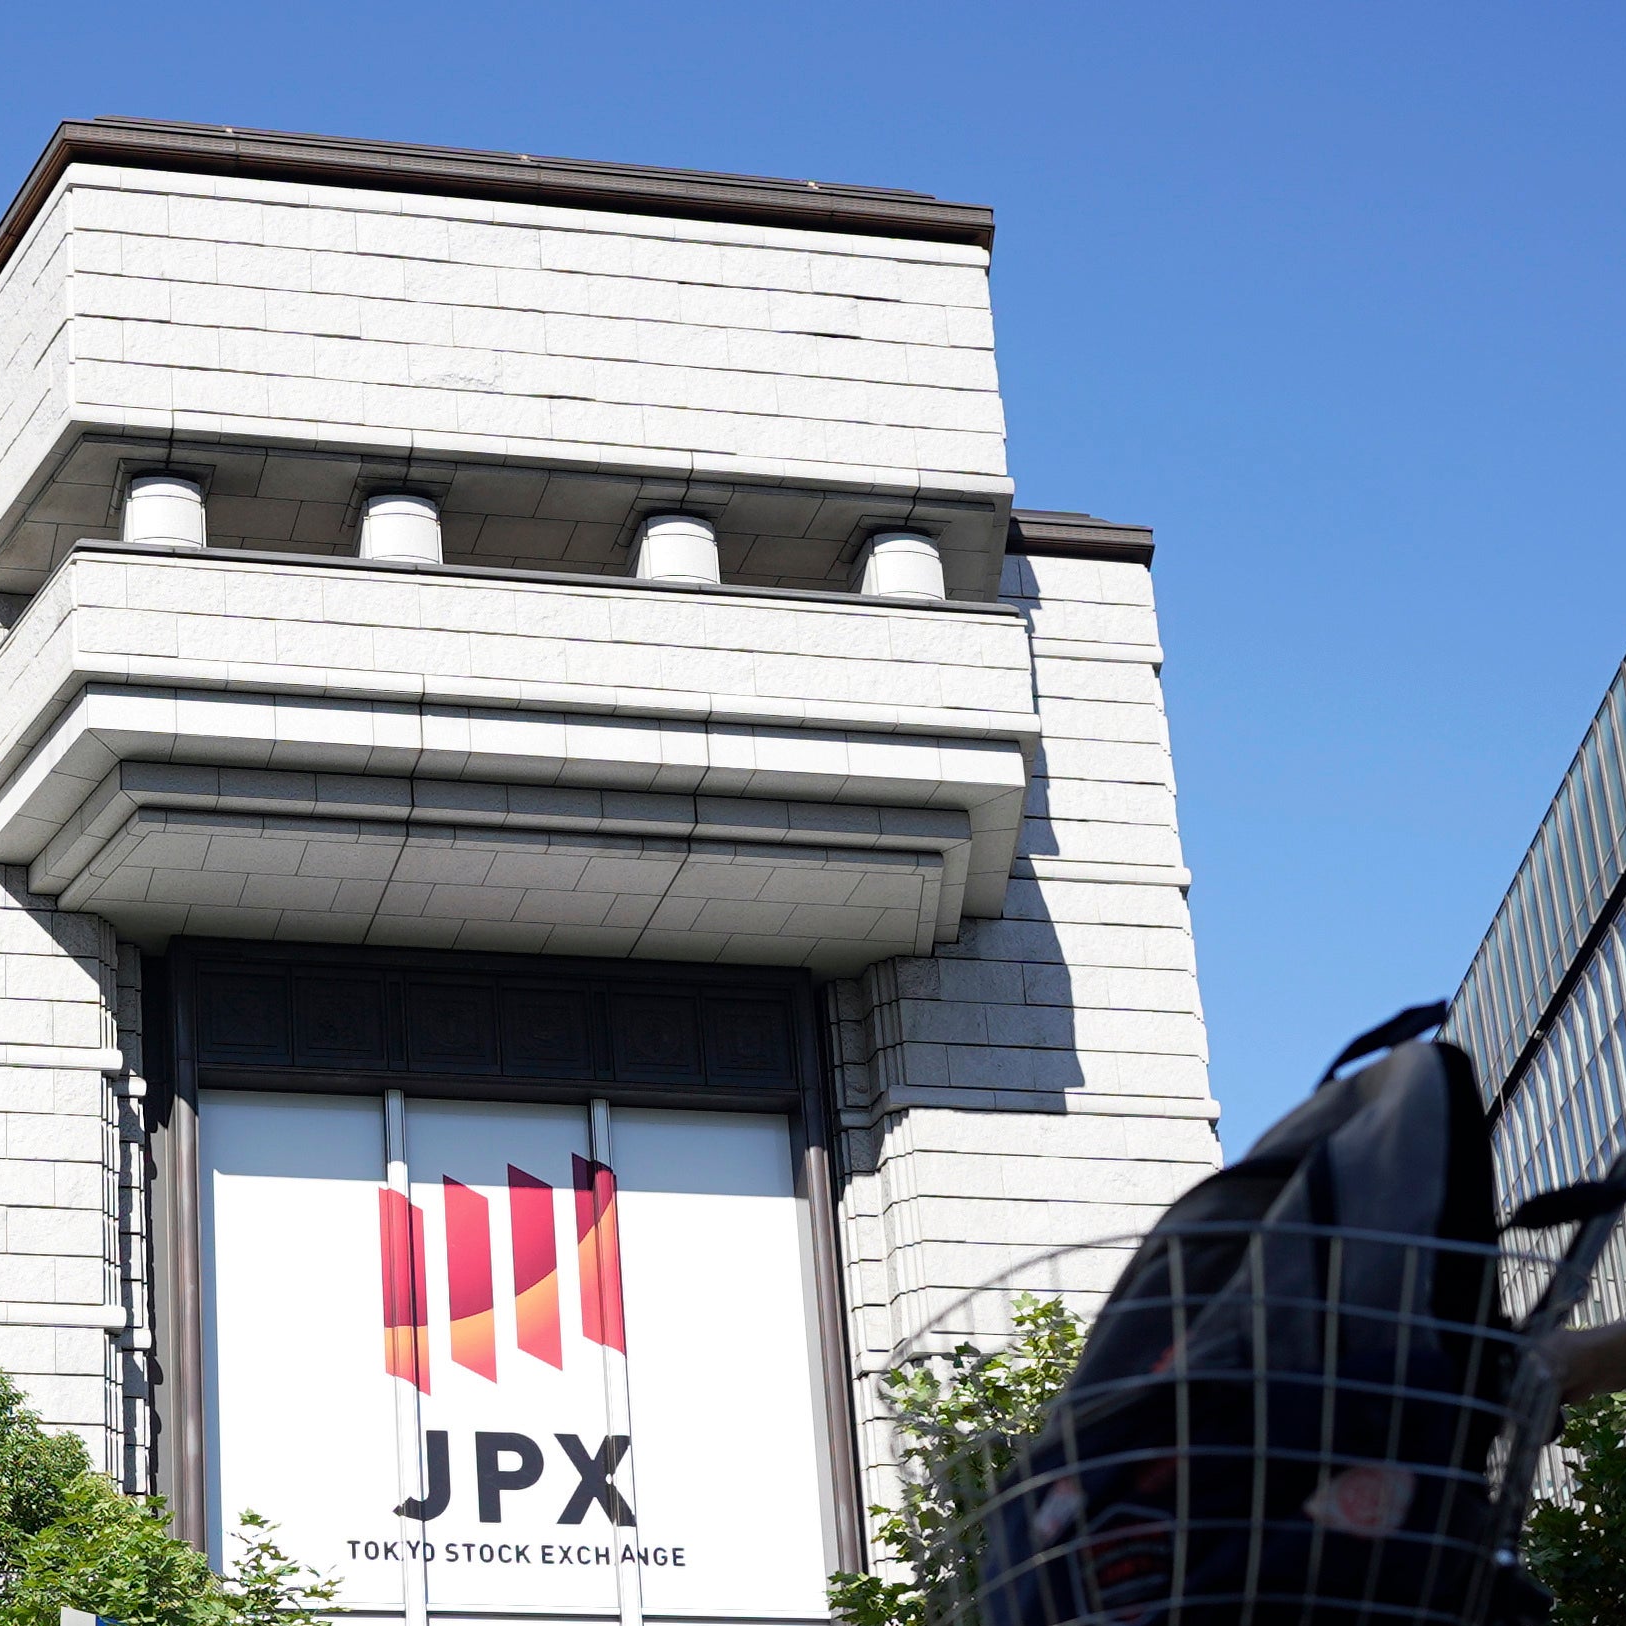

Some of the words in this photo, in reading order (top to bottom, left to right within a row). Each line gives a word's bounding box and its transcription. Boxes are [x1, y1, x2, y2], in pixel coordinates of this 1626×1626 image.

[393, 1430, 636, 1527] JPX
[347, 1539, 435, 1562] TOKYO
[445, 1543, 532, 1564] STOCK
[541, 1544, 686, 1567] EXCHANGE
